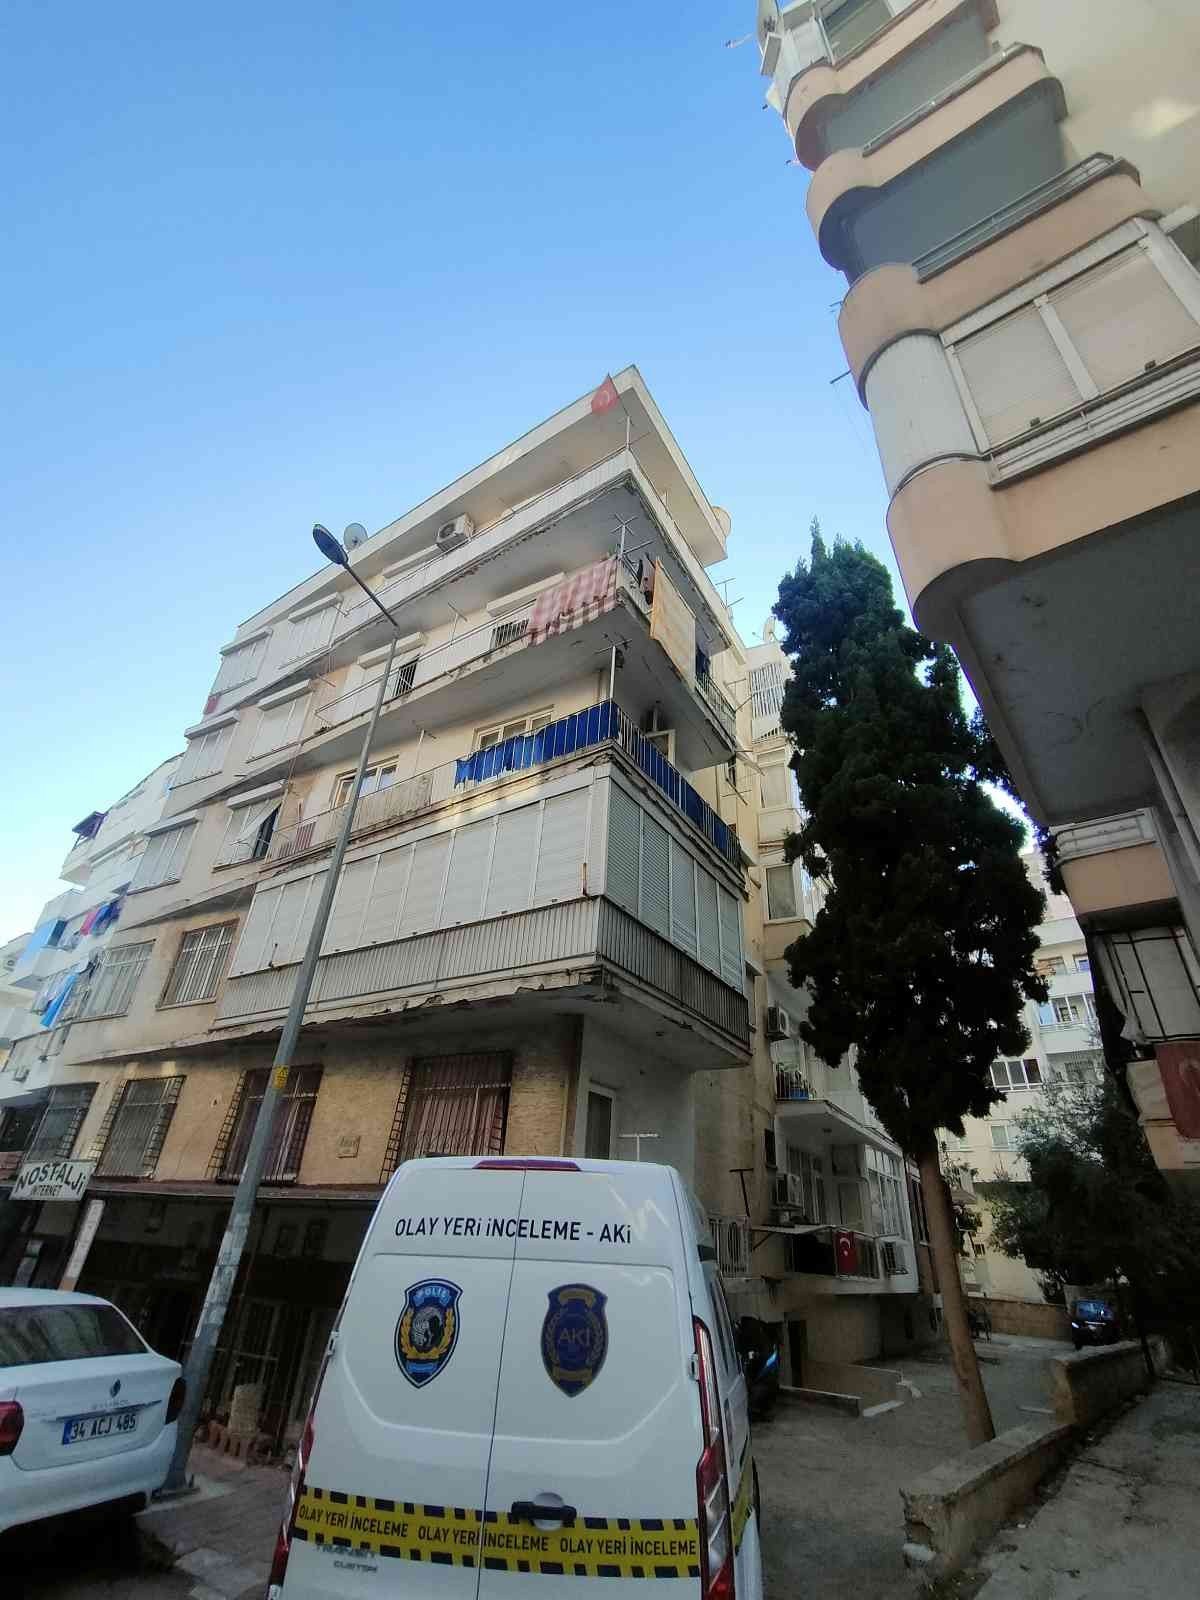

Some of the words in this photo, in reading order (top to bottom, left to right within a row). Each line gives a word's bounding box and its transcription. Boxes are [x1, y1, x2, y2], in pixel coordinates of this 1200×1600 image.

[395, 1217, 439, 1236] OLAY
[71, 1422, 86, 1440] 34
[91, 1417, 112, 1436] ACJ
[299, 1504, 323, 1522] OLAY
[418, 1526, 449, 1543] OLAY
[560, 1538, 593, 1554] OLAY
